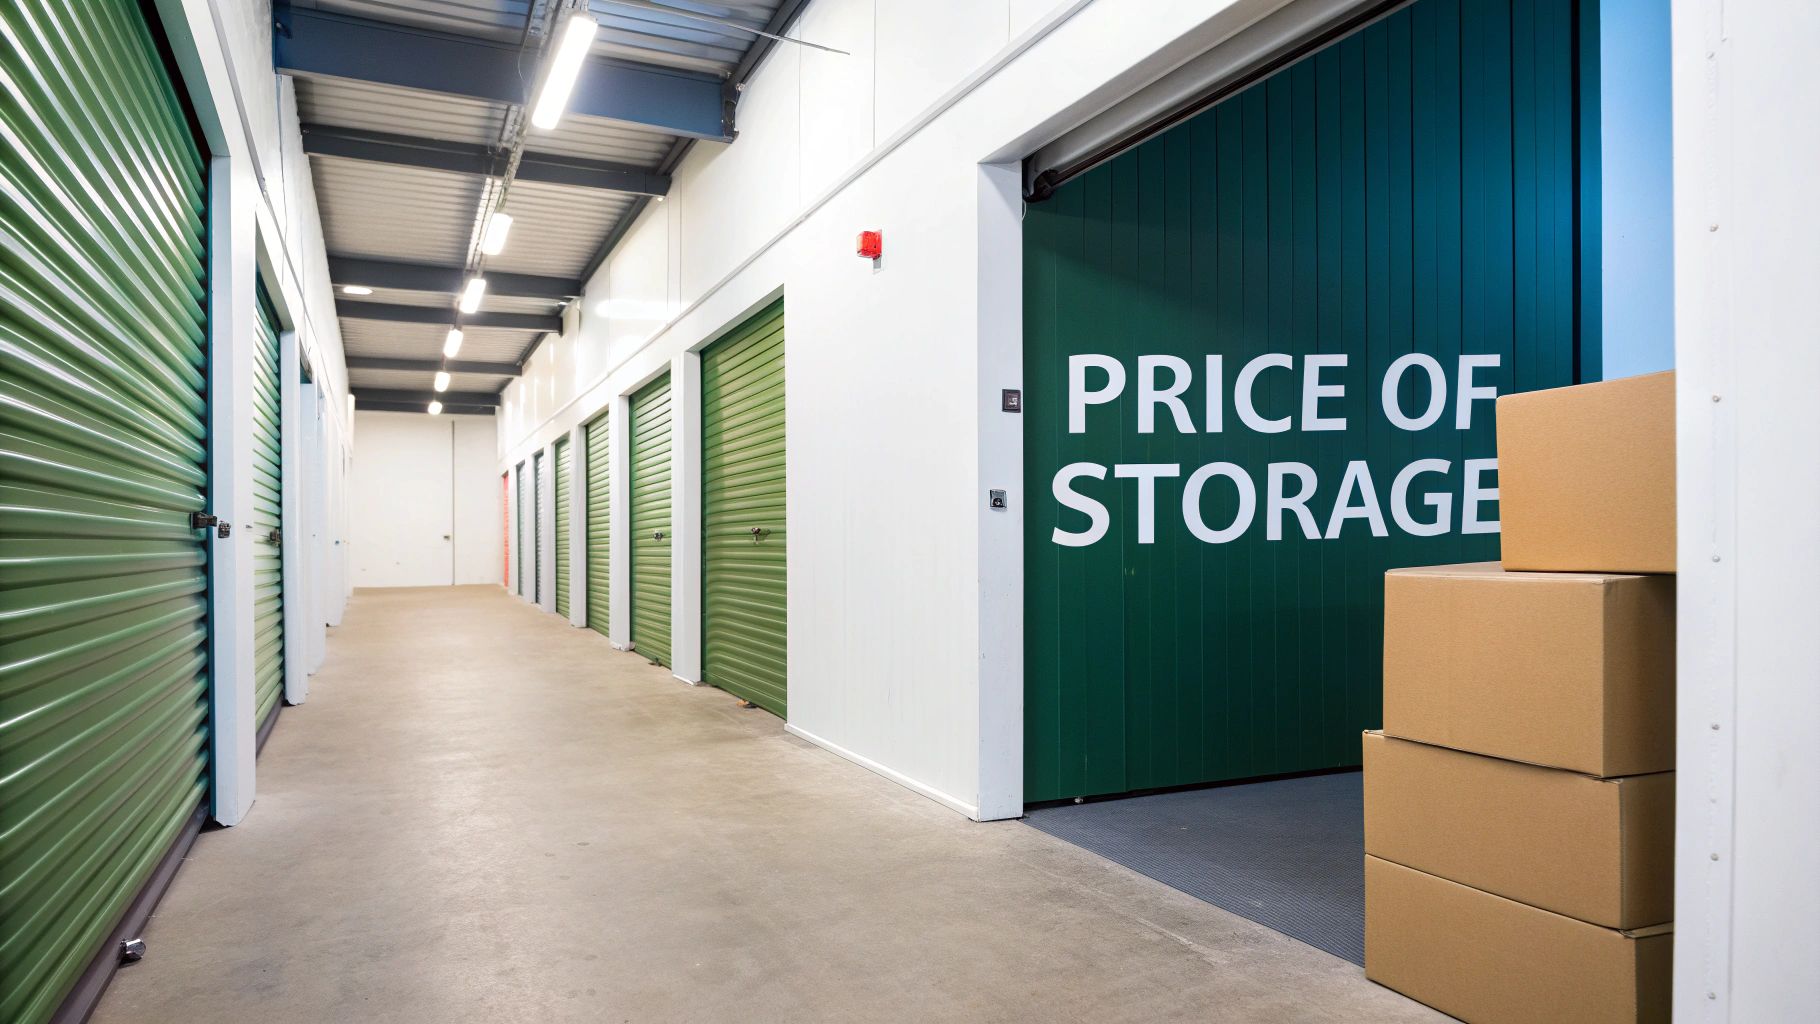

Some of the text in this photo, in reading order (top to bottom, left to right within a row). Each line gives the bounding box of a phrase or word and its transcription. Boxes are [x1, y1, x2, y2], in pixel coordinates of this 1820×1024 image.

[1068, 352, 1501, 434] PRICE OF
[1051, 458, 1501, 547] STORAGE
